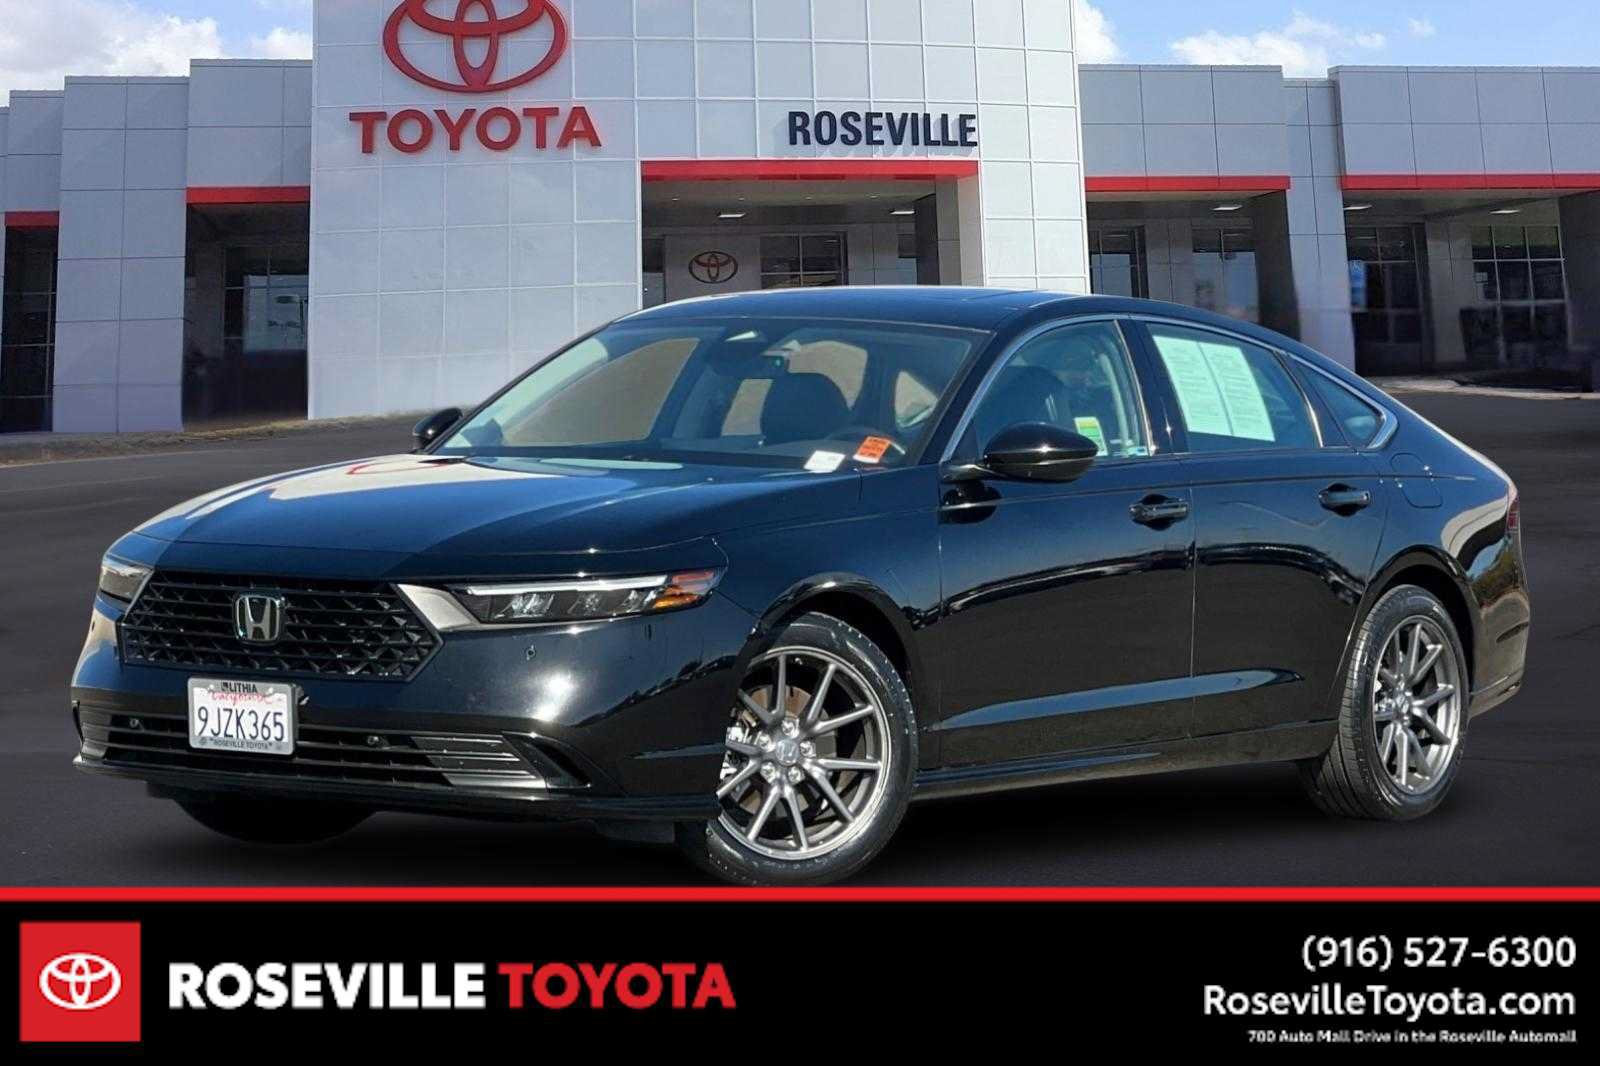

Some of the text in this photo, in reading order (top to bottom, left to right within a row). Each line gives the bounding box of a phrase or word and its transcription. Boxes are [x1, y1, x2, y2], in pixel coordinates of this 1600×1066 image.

[349, 106, 602, 154] TOYOTA
[788, 110, 978, 147] ROSEVILLE
[229, 682, 258, 693] LITHIA
[197, 706, 285, 742] 9JZK365
